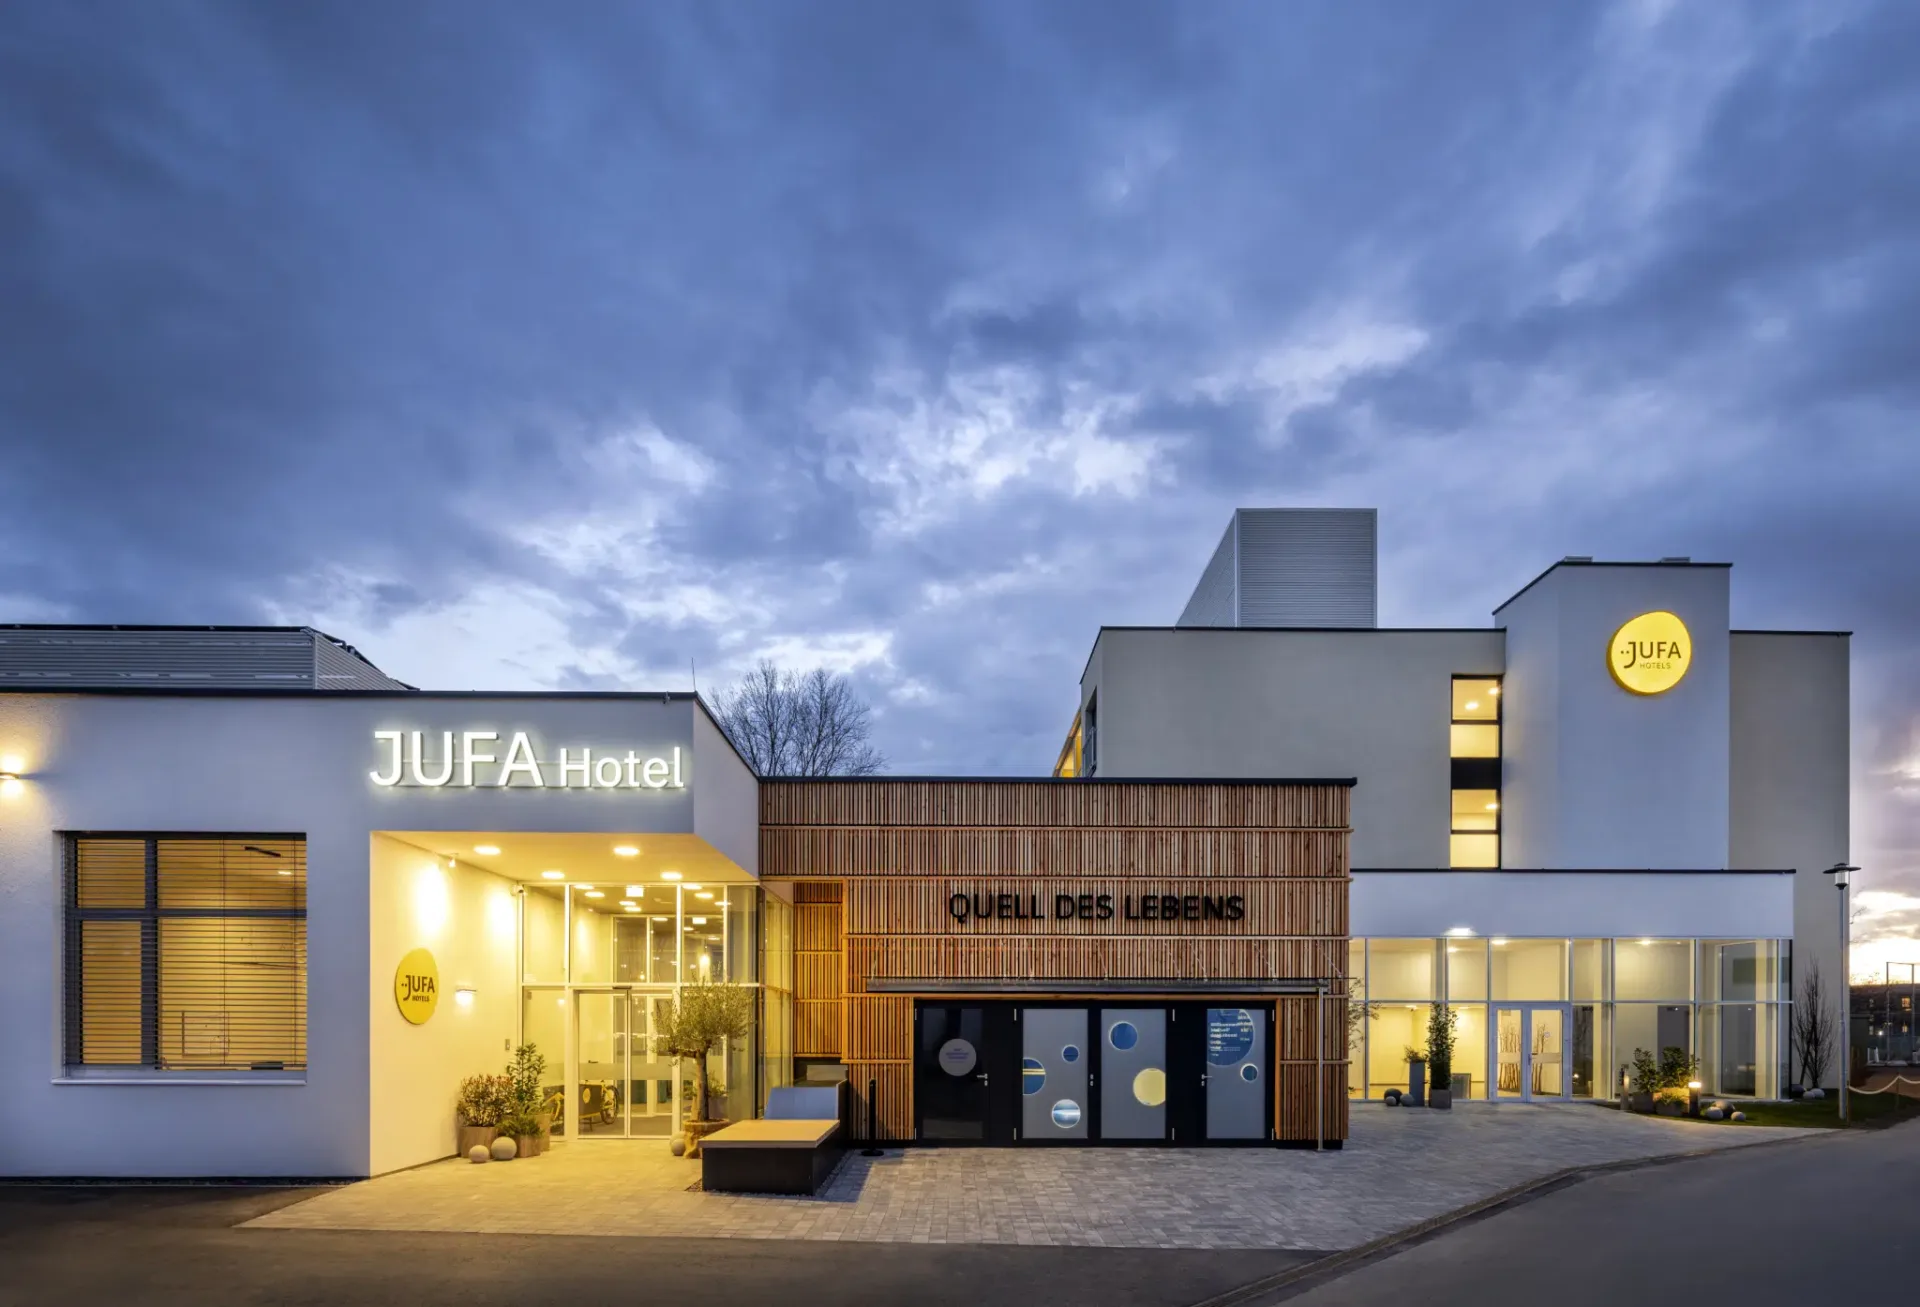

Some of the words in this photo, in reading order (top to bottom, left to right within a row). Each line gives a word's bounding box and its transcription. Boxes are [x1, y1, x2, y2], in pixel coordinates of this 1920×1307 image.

[1623, 641, 1682, 669] JUFA
[1639, 662, 1672, 670] HOTELS
[369, 731, 545, 787] JUFA
[559, 746, 684, 788] Hotel
[949, 893, 1045, 924] QUELL
[1055, 894, 1114, 920] DES
[1125, 894, 1246, 921] LEBENS
[402, 974, 435, 1002] JUFA
[411, 994, 431, 1003] HOTELS
